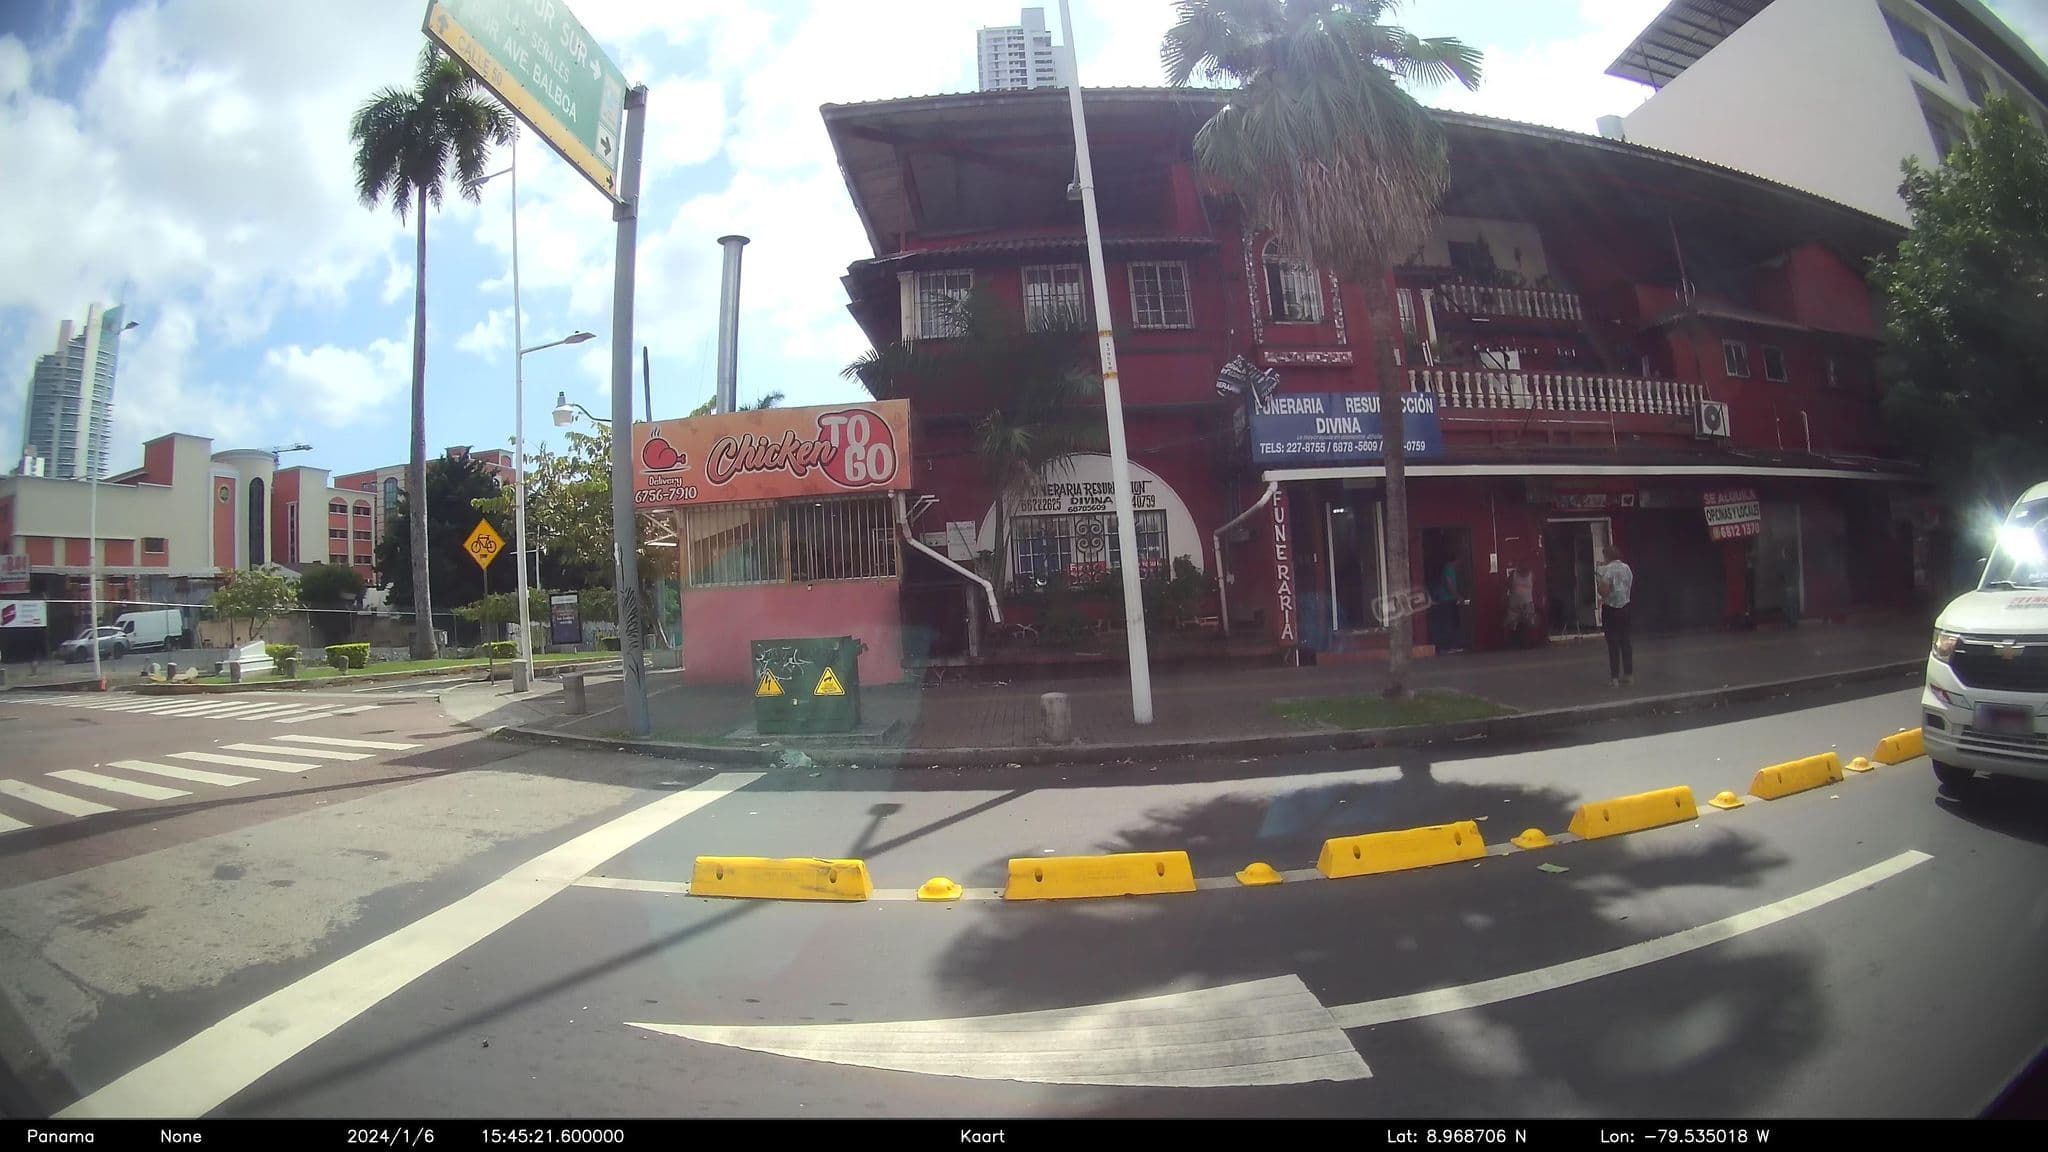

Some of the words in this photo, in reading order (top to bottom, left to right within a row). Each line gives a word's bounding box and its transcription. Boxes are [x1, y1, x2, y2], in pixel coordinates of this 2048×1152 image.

[458, 35, 490, 78] CALLE
[560, 25, 588, 68] SUR
[503, 36, 530, 74] AVE.
[532, 63, 577, 123] BALBOA
[820, 414, 870, 448] TO
[1316, 417, 1361, 434] DIVINA
[706, 429, 839, 485] Chicken
[844, 442, 892, 481] GO
[1260, 442, 1284, 454] TELS:
[1286, 441, 1325, 454] 227-8755
[635, 486, 698, 503] 6756-7910
[648, 475, 682, 487] Delivery
[1071, 496, 1113, 505] DIVINA
[1272, 491, 1294, 640] FUNERARIA
